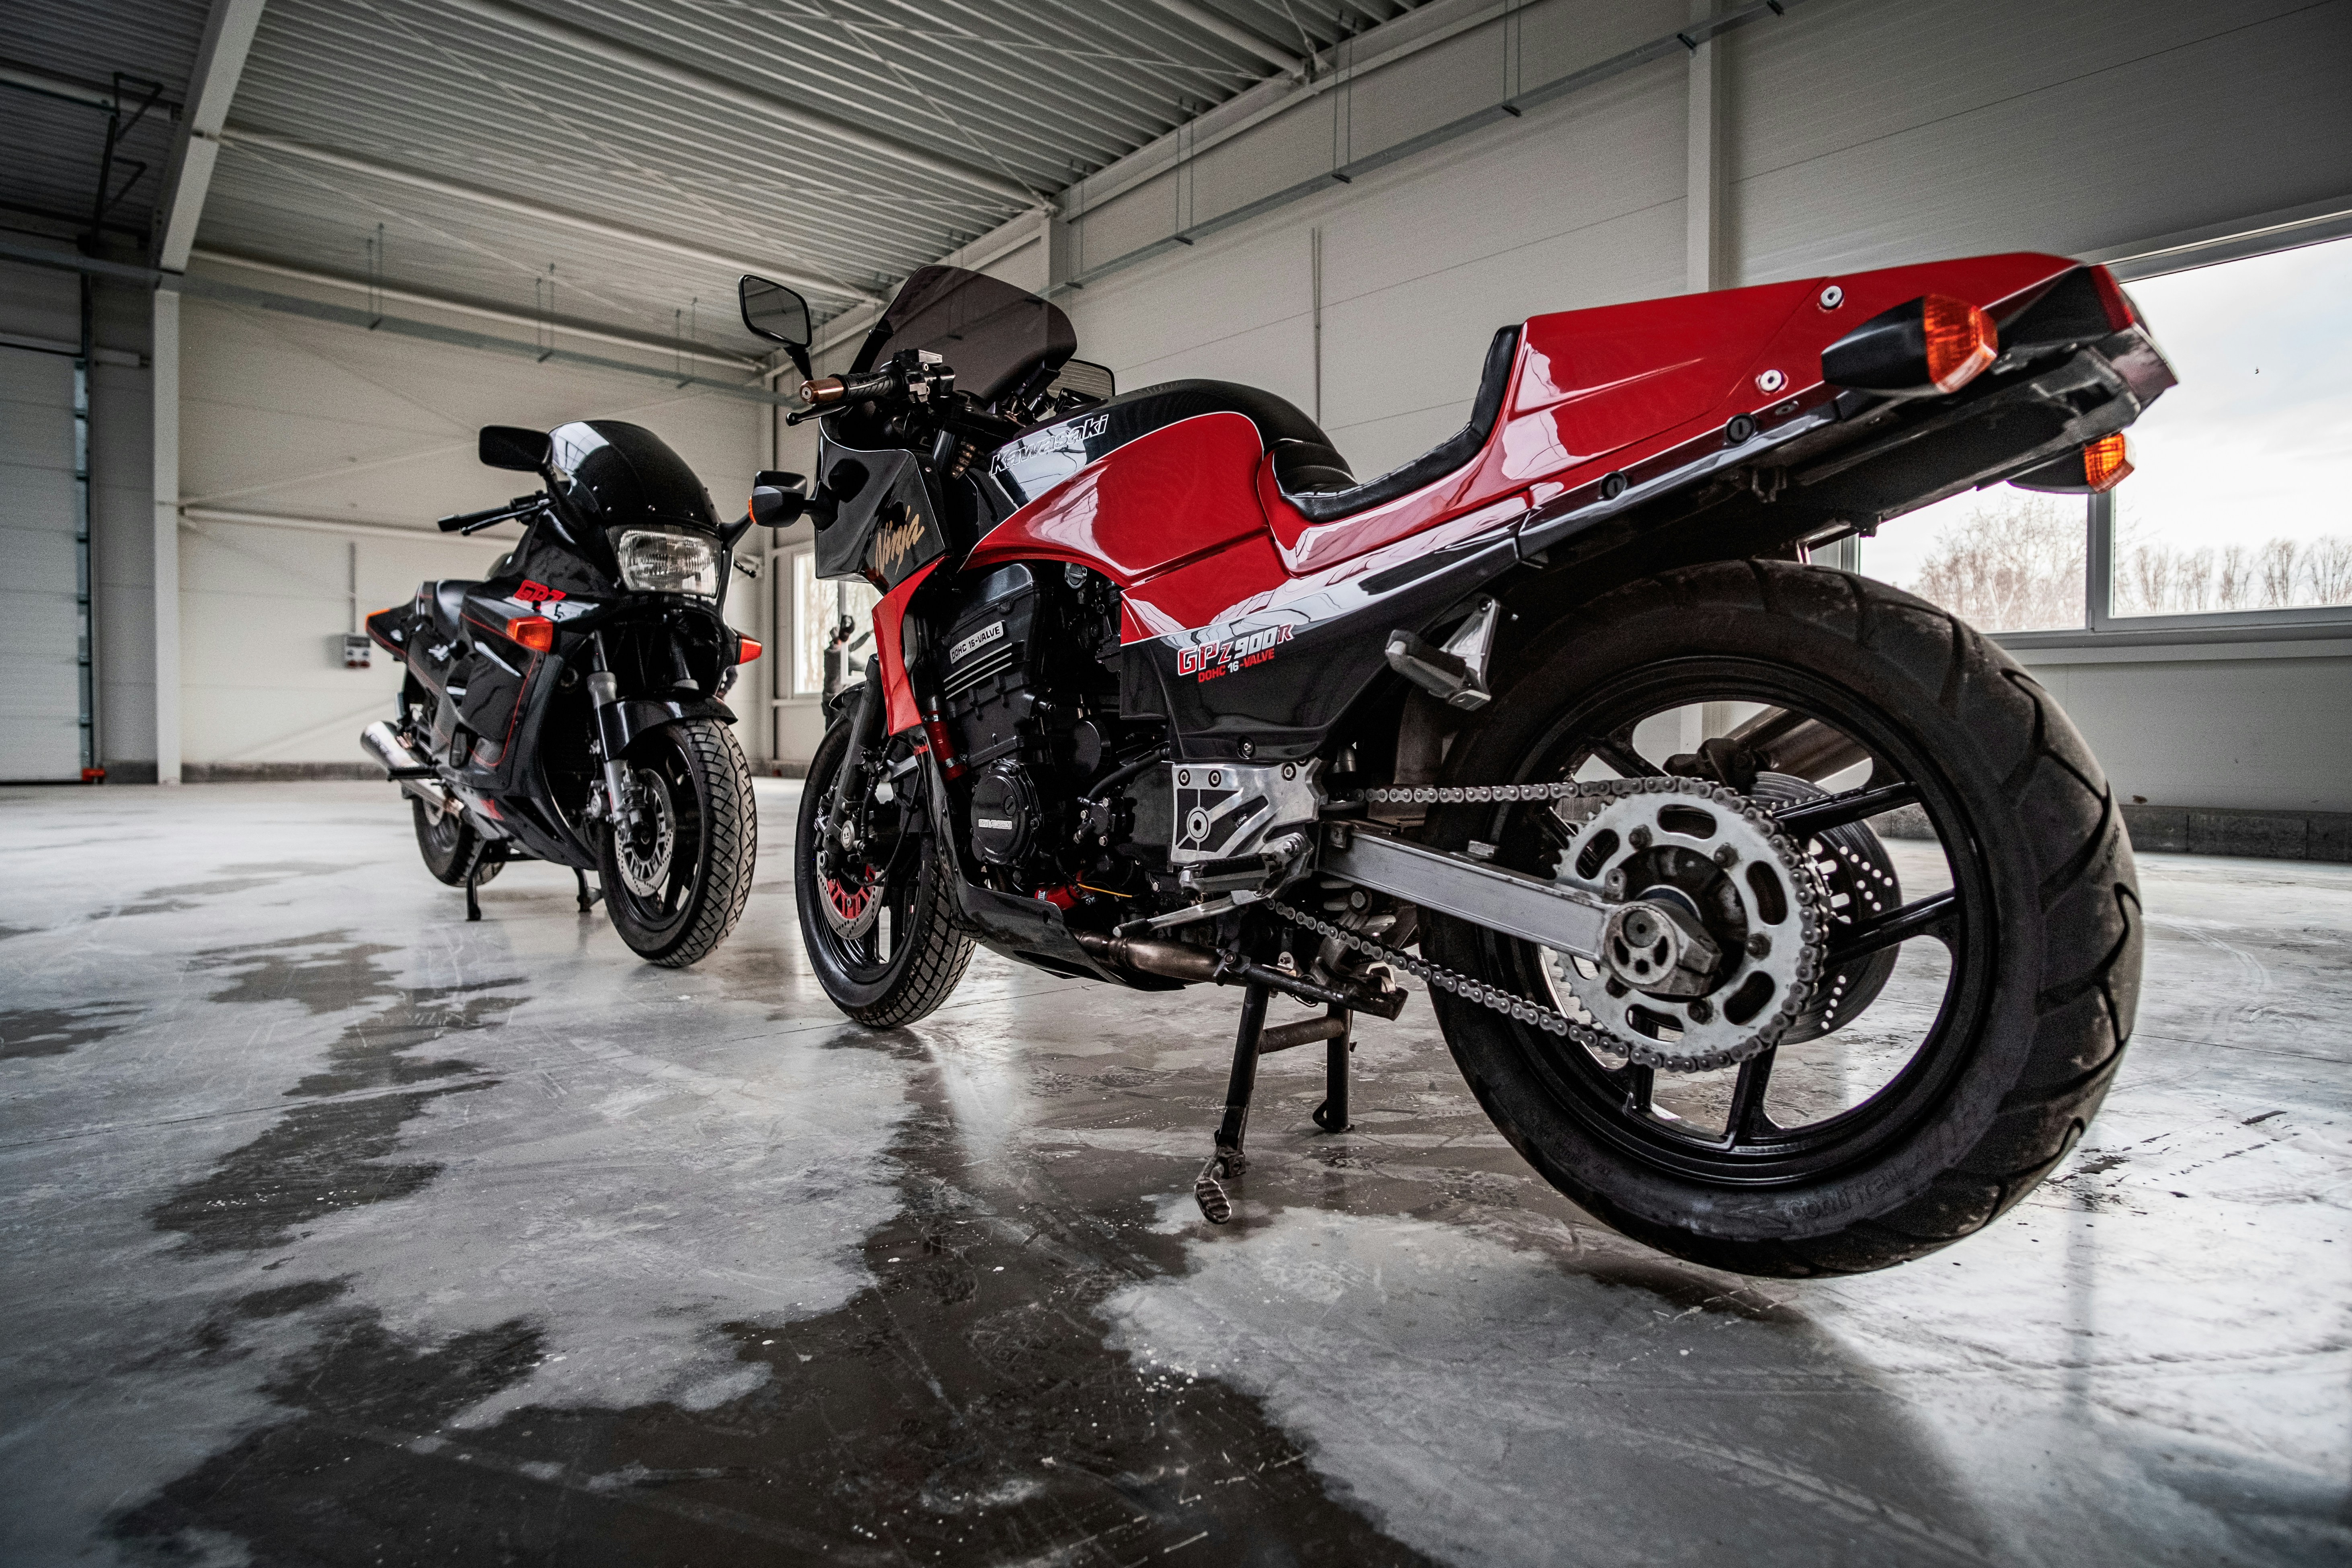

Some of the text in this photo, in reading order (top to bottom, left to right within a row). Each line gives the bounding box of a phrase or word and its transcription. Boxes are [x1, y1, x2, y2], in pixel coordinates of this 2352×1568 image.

[990, 414, 1109, 476] Kawasaki
[875, 505, 925, 577] Ninja
[952, 626, 1000, 660] DOHC 16-VALVE
[1198, 648, 1275, 683] DOHC 16-VALVE
